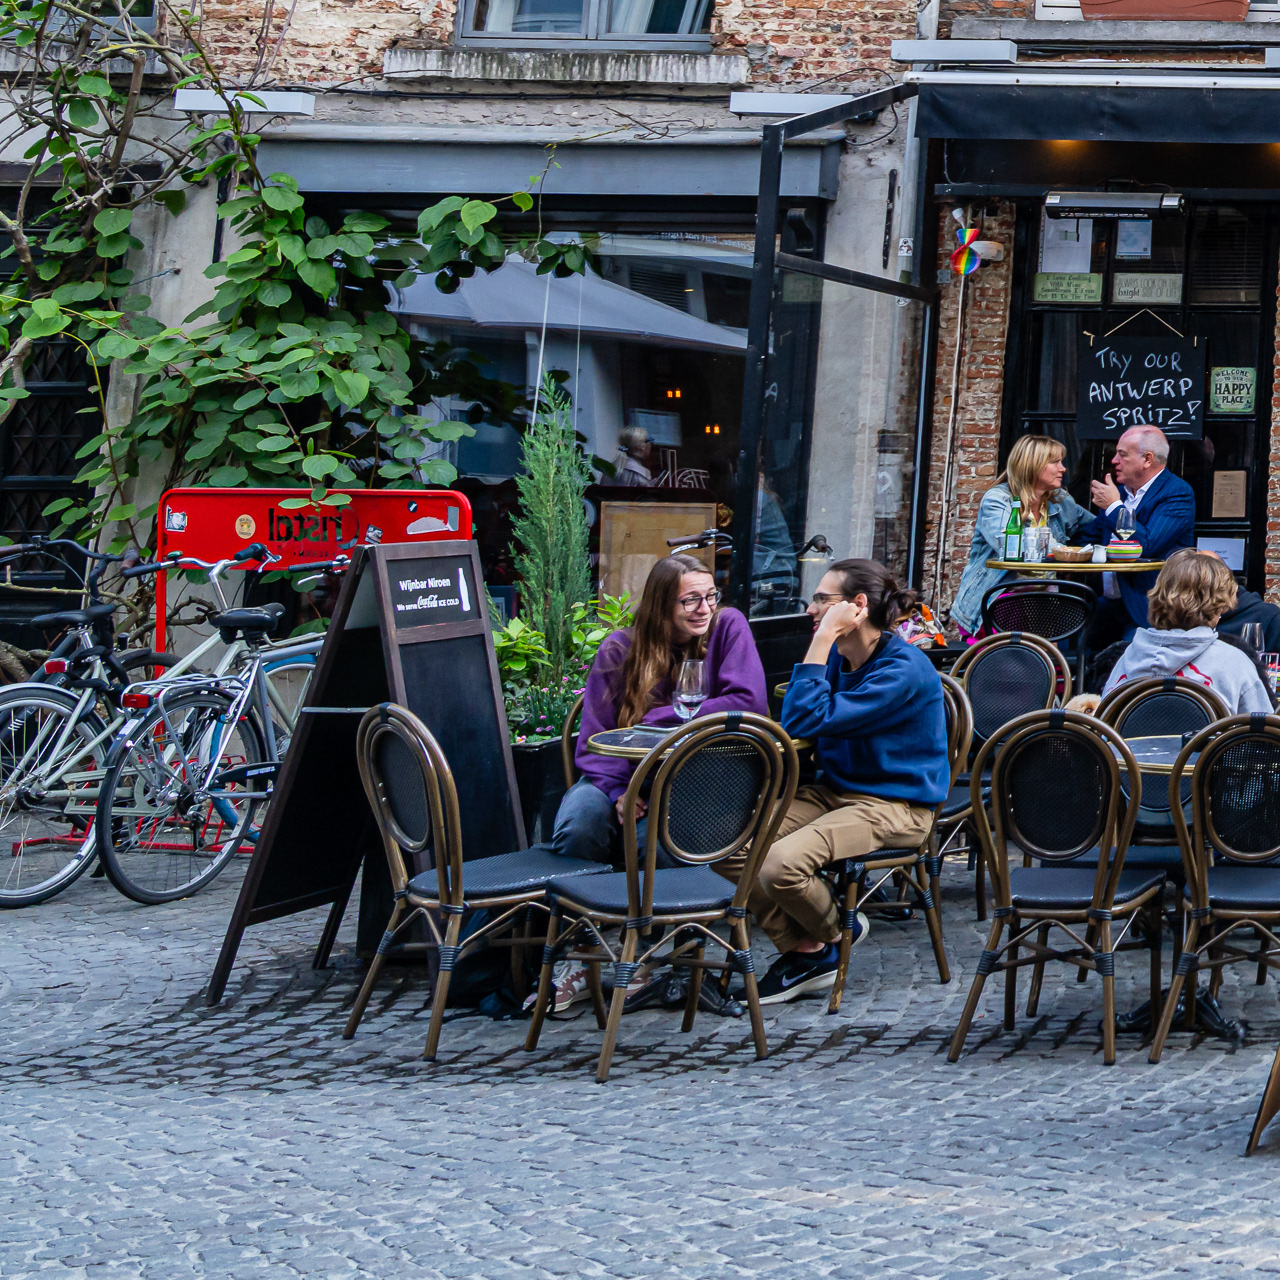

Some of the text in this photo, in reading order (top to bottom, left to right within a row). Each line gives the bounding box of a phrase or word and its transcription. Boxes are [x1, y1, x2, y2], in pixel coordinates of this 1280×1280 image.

[1095, 347, 1182, 378] TRY OUR
[1215, 369, 1249, 377] WELCOME
[1089, 377, 1193, 404] ANTWERP
[1214, 383, 1253, 395] HAPPY
[399, 577, 451, 592] Wijnbar Niroen
